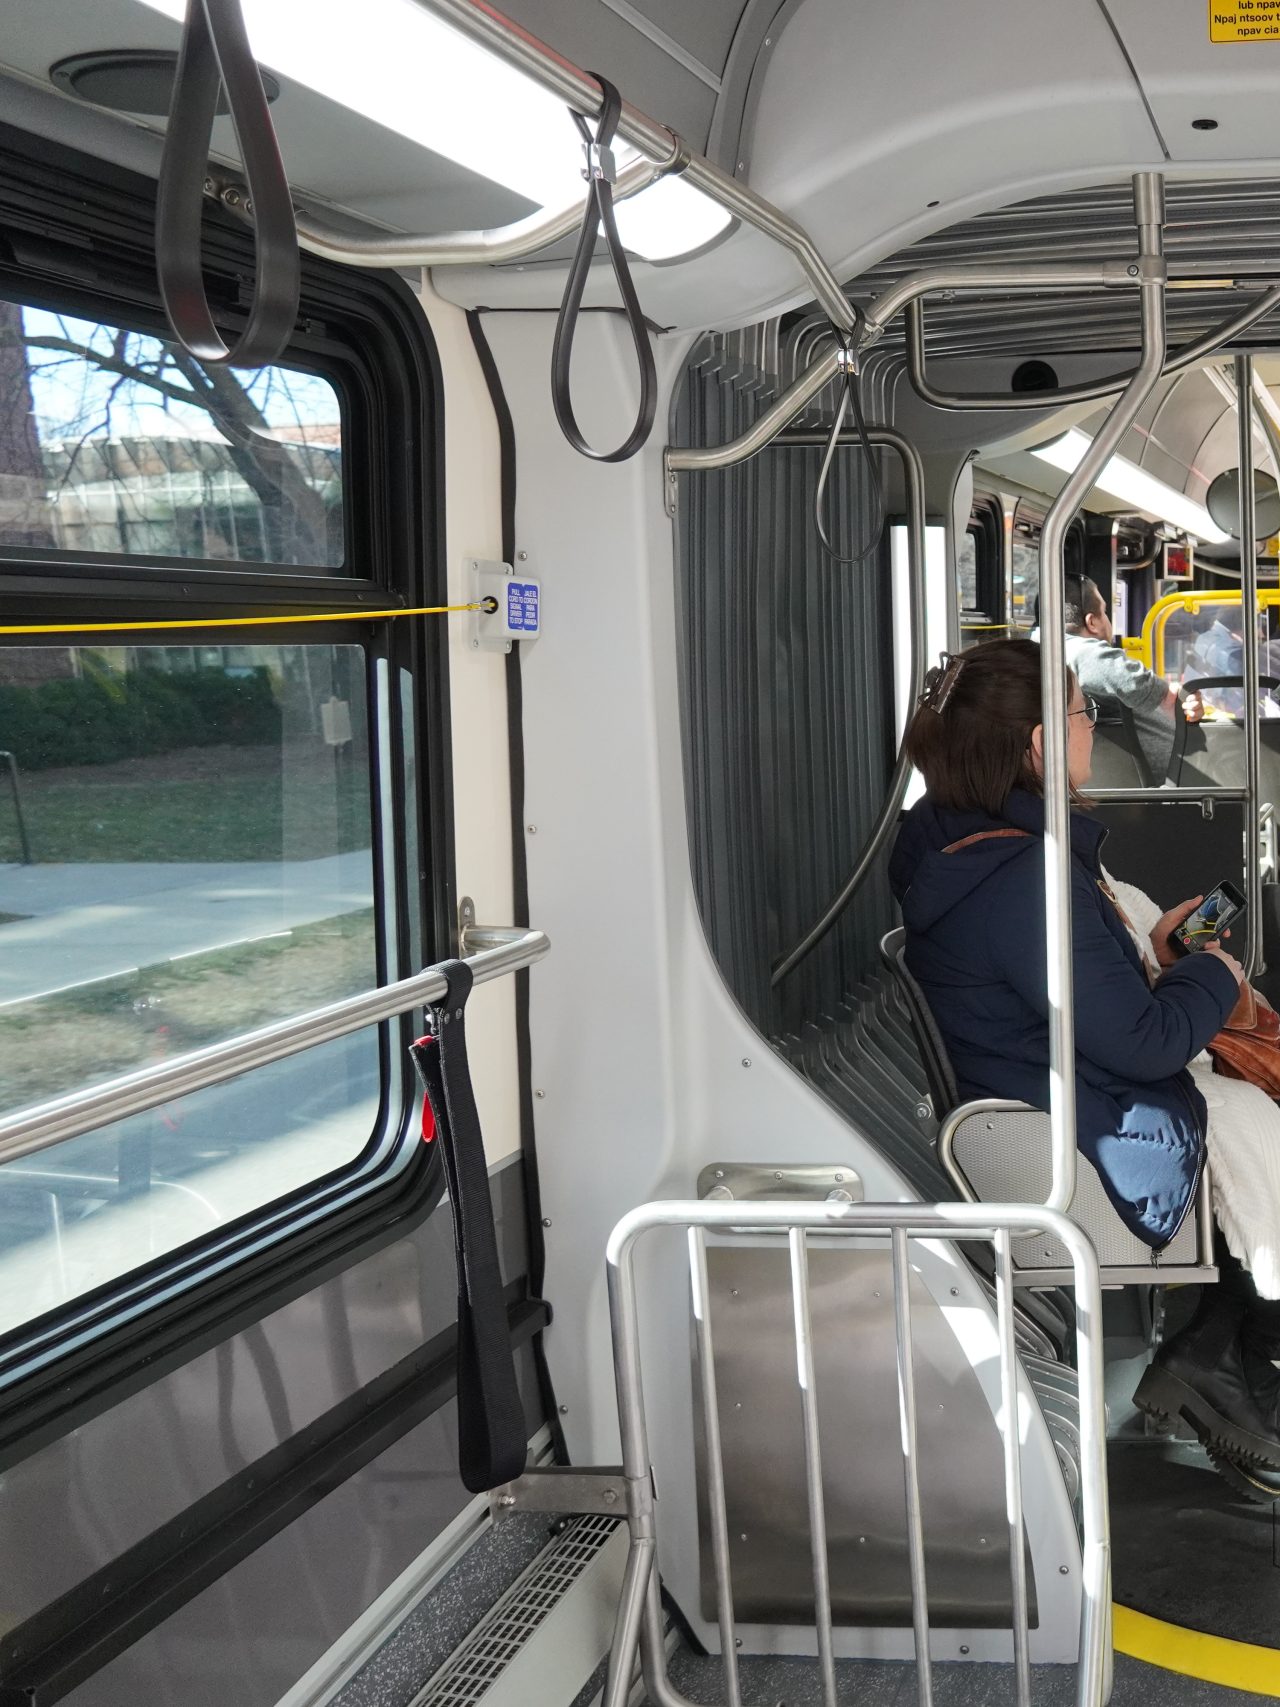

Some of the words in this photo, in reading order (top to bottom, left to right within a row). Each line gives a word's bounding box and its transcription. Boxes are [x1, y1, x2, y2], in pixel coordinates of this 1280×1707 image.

[1238, 1, 1254, 10] lub
[1256, 1, 1280, 11] npav
[1214, 14, 1237, 25] Npaj
[1239, 13, 1274, 23] ntsoov
[1237, 26, 1262, 37] npav
[1264, 24, 1279, 34] cia
